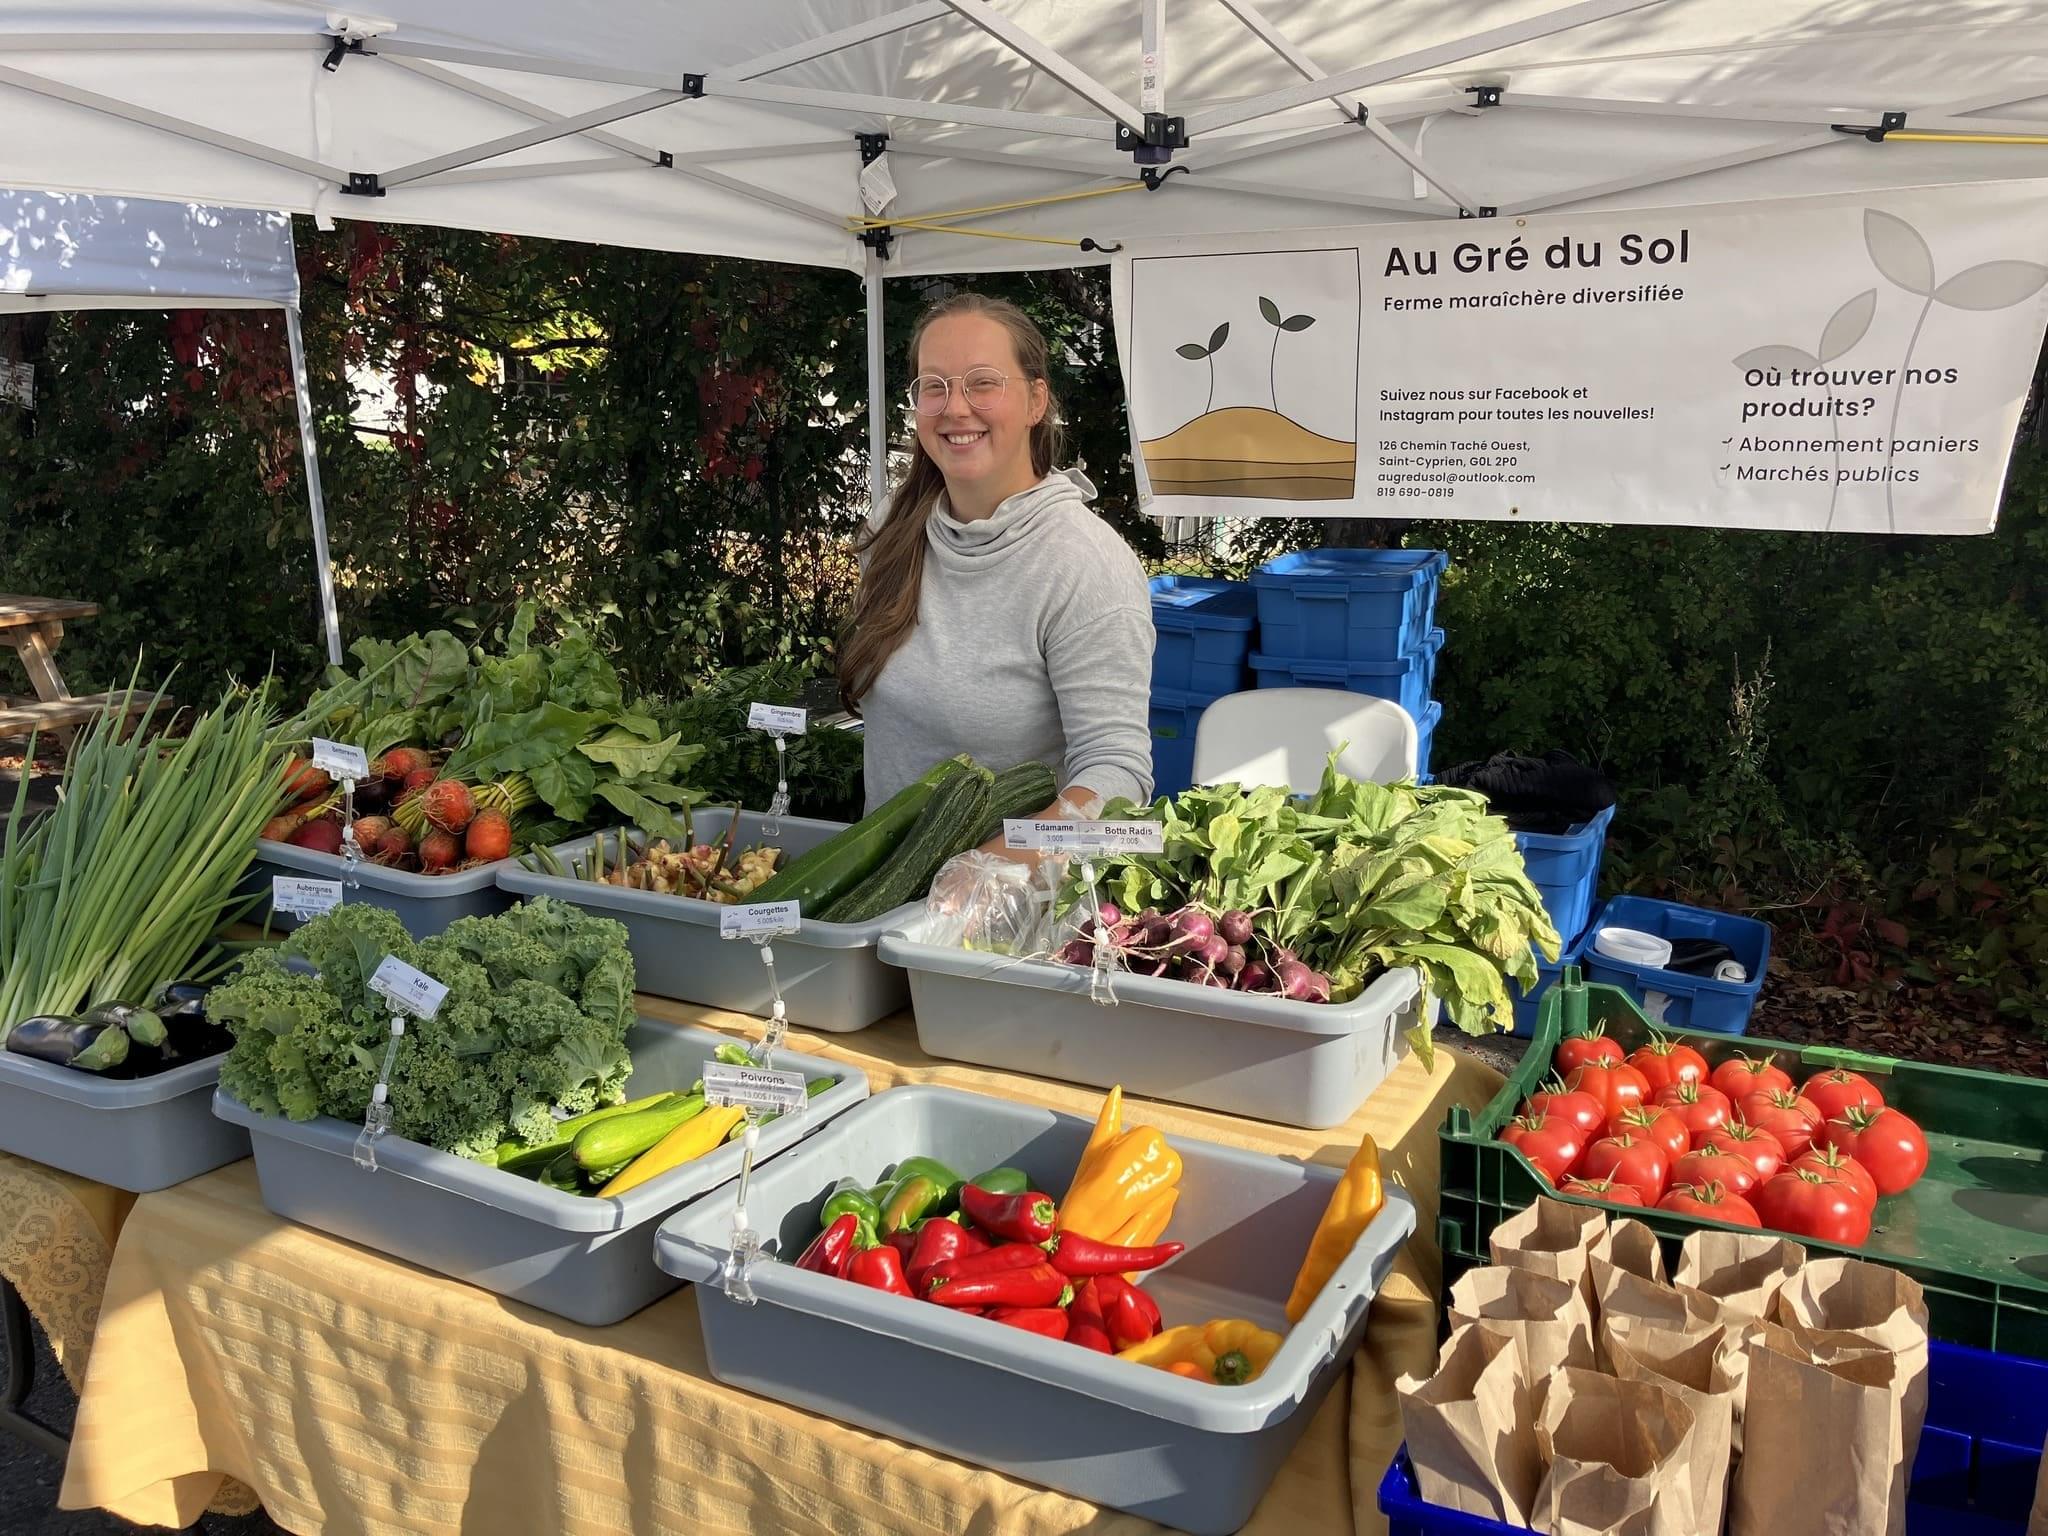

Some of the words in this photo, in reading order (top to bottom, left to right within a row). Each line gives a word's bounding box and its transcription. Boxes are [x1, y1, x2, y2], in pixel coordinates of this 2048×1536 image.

[1384, 247, 1437, 277] Au
[1453, 236, 1529, 273] Gré
[1545, 237, 1601, 269] du
[1619, 230, 1689, 265] Sol
[1384, 297, 1443, 311] Ferme
[1449, 290, 1566, 308] maraîchère
[1572, 284, 1684, 305] diversifiée
[1744, 366, 1781, 387] Où
[1791, 368, 1896, 387] trouver
[1905, 367, 1958, 385] nos
[1380, 389, 1425, 401] Suivez
[1429, 390, 1465, 401] nous
[1468, 389, 1492, 400] sur
[1495, 387, 1569, 400] Facebook
[1572, 388, 1588, 399] et
[1379, 409, 1454, 424] Instagram
[1458, 410, 1492, 424] pour
[1496, 408, 1544, 420] toutes
[1548, 407, 1569, 420] les
[1573, 407, 1654, 420] nouvelles!
[1742, 397, 1876, 423] produits?
[1379, 441, 1397, 451] 126
[1400, 440, 1447, 451] Chemin
[1450, 440, 1488, 451] Taché
[1490, 441, 1531, 452] Ouest,
[1739, 436, 1883, 453] Abonnement
[1890, 437, 1979, 457] paniers
[1379, 456, 1466, 469] Saint-Cyprien,
[1377, 472, 1535, 485] augredusol@outlook.com
[1737, 465, 1829, 482] Marchés
[1836, 465, 1920, 486] publics
[1376, 487, 1395, 497] 819
[1398, 487, 1454, 498] 690-0819
[1035, 823, 1074, 832] Edamame
[1105, 827, 1127, 835] Botte
[1128, 827, 1153, 836] Radis
[296, 883, 333, 894] Aubergines
[748, 906, 789, 916] Courgettes
[413, 977, 429, 991] Kale
[740, 1071, 785, 1085] Poivrons
